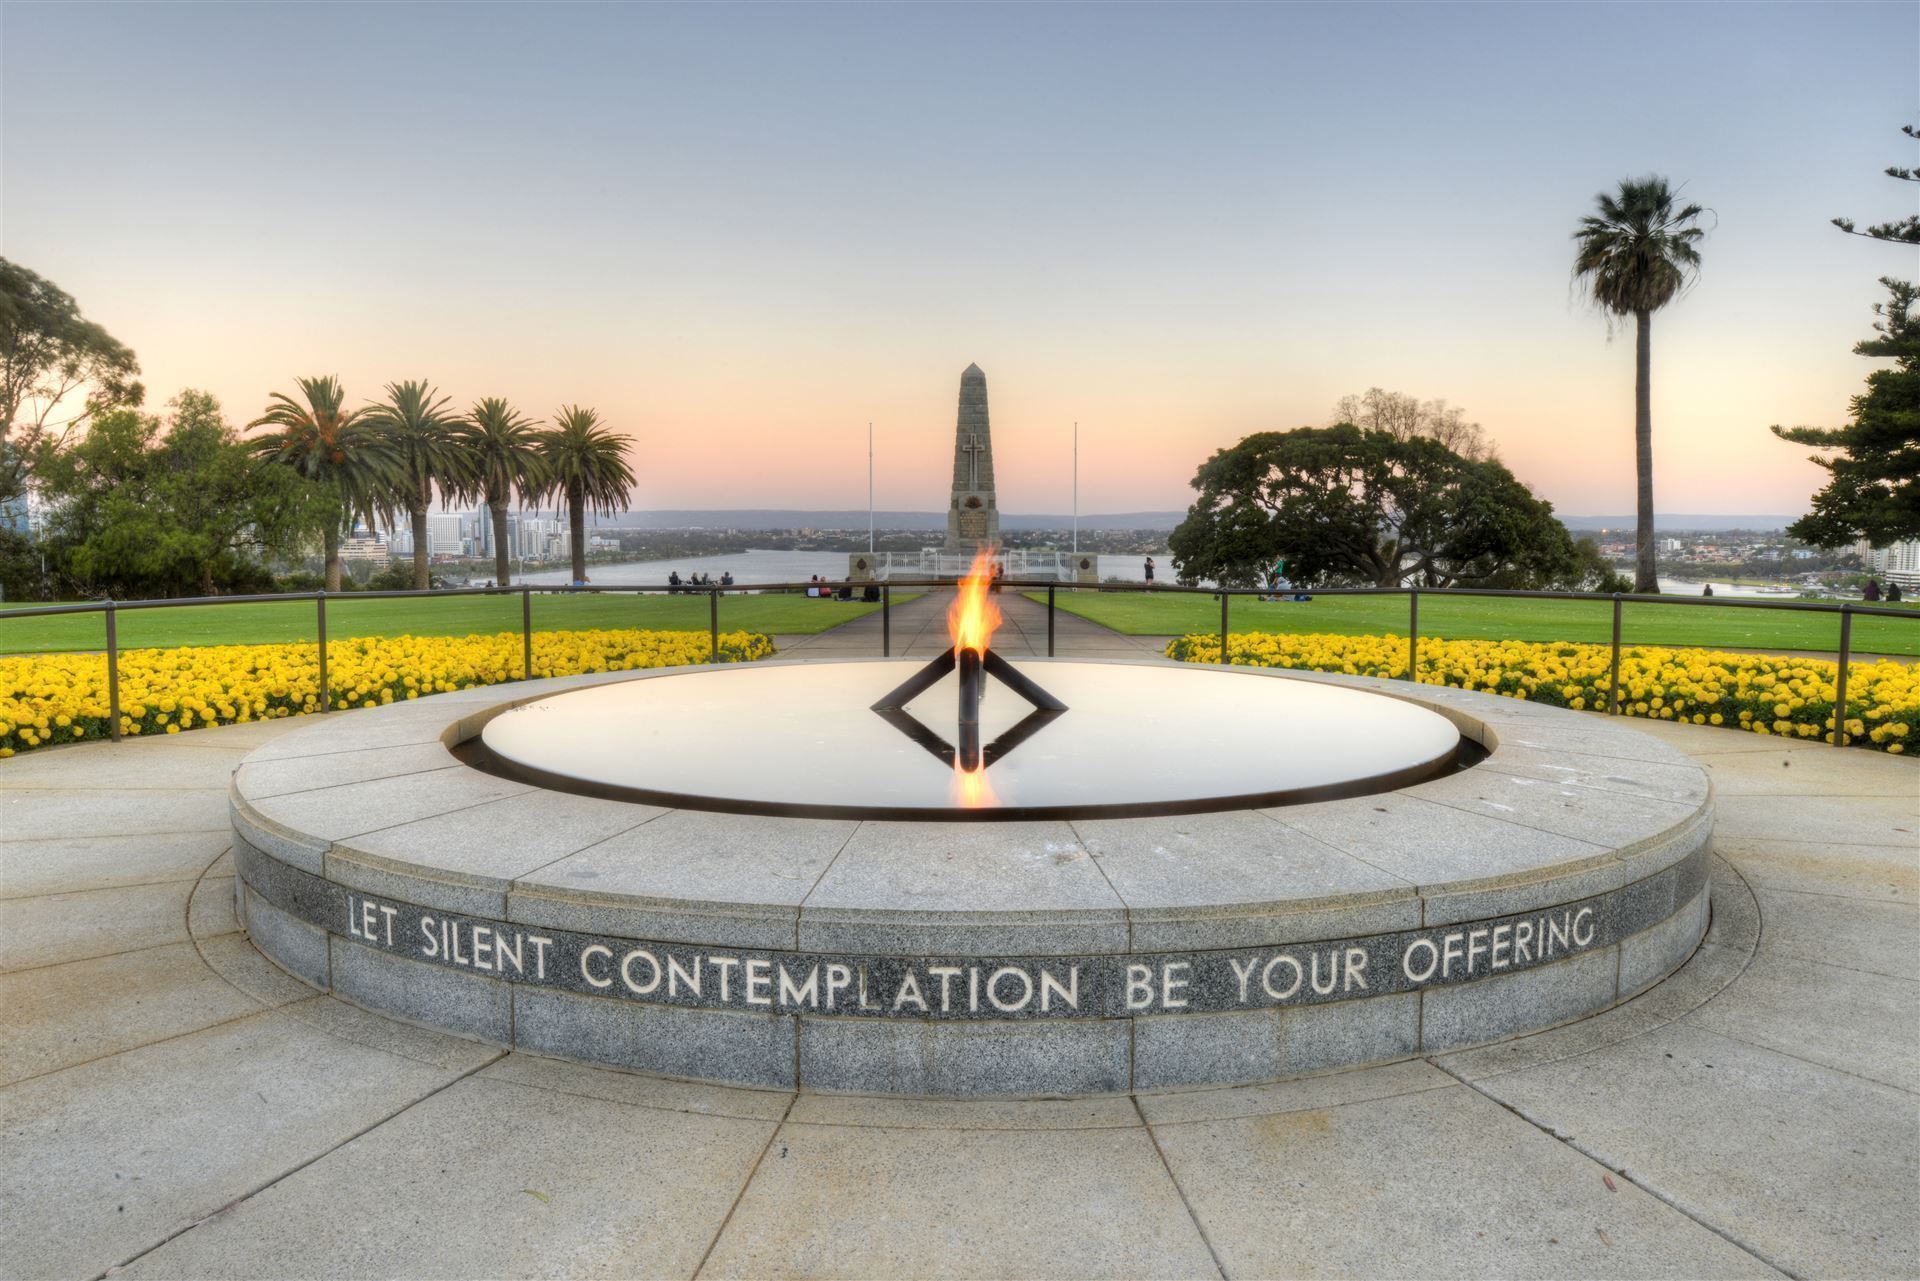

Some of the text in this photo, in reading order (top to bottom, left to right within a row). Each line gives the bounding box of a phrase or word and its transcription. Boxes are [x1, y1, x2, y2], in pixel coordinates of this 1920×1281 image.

[349, 896, 1595, 1013] LET SILENT CONTEMPLATION BE YOUR OFFERING
